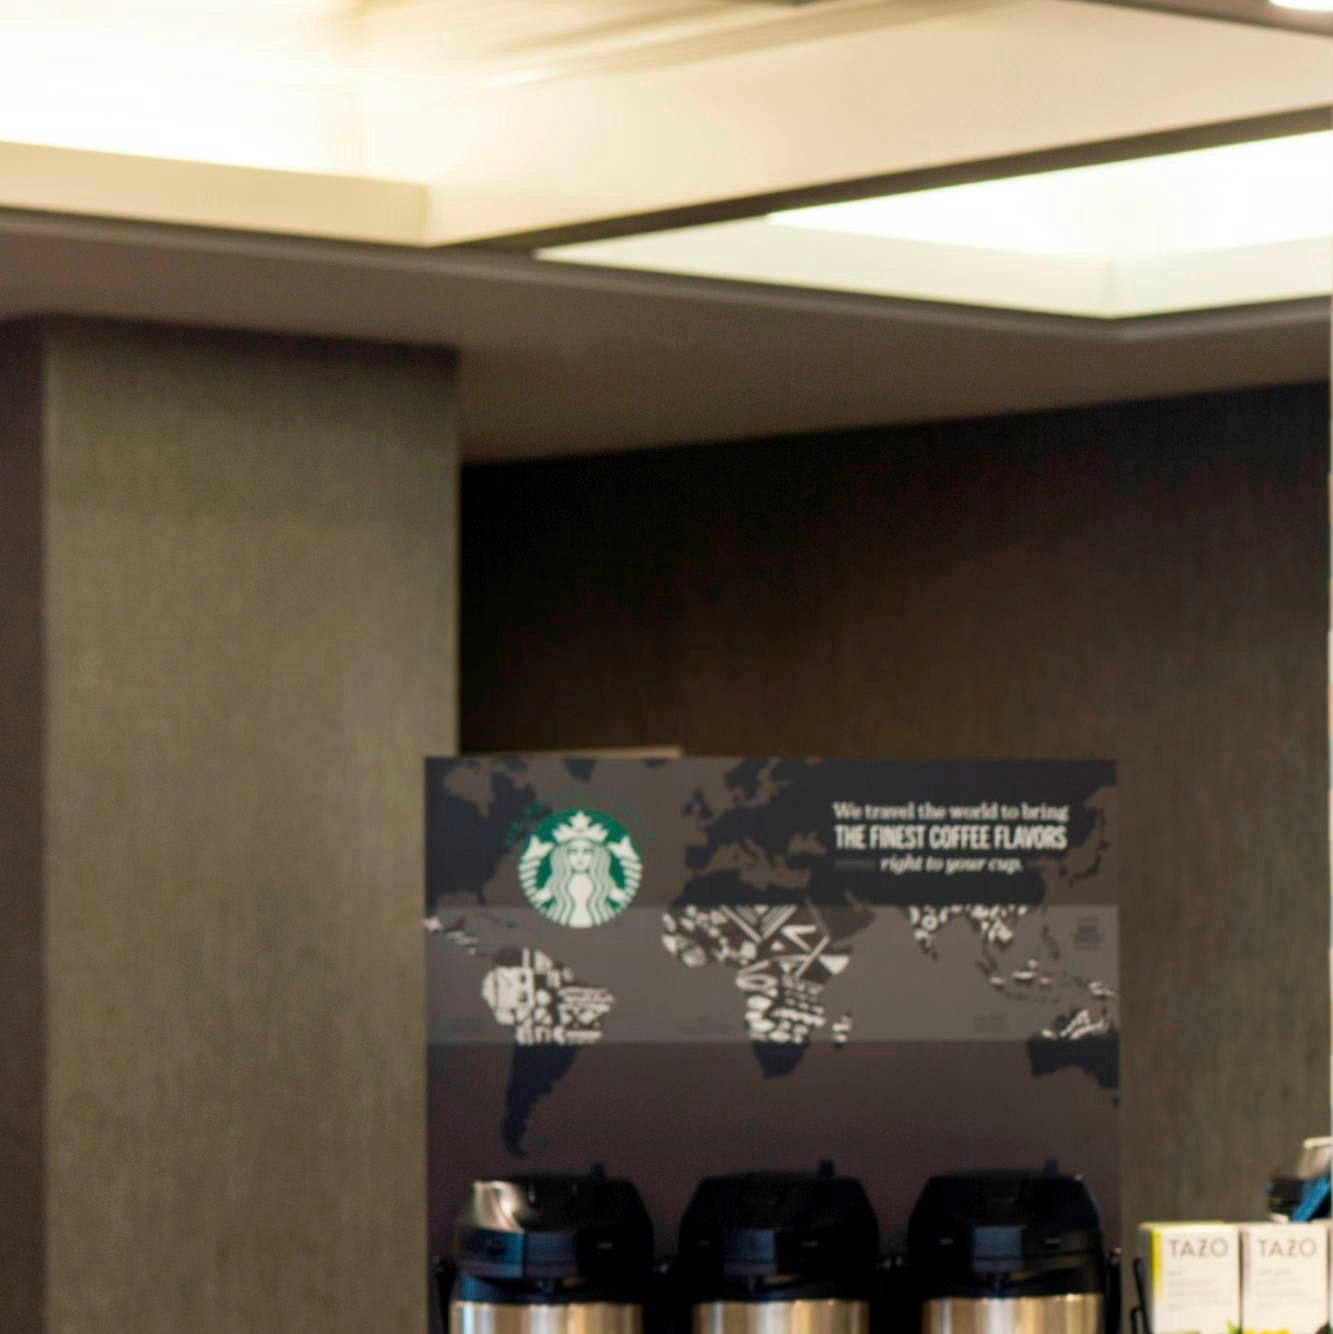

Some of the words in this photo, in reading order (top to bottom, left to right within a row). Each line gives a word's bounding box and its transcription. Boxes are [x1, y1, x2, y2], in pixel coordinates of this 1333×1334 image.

[832, 802, 861, 819] We
[864, 802, 915, 819] travel
[917, 802, 946, 819] the
[949, 802, 998, 819] world
[1001, 803, 1019, 819] to
[1021, 802, 1069, 823] bring
[834, 825, 867, 849] THE
[869, 825, 926, 849] FINEST
[928, 825, 991, 850] COFFEE
[993, 825, 1068, 850] FLAVORS
[880, 854, 923, 875] right
[925, 857, 944, 871] to
[945, 857, 988, 875] your
[988, 858, 1023, 875] cup.
[1168, 1237, 1229, 1258] TAZO
[1257, 1237, 1318, 1258] TAZO
